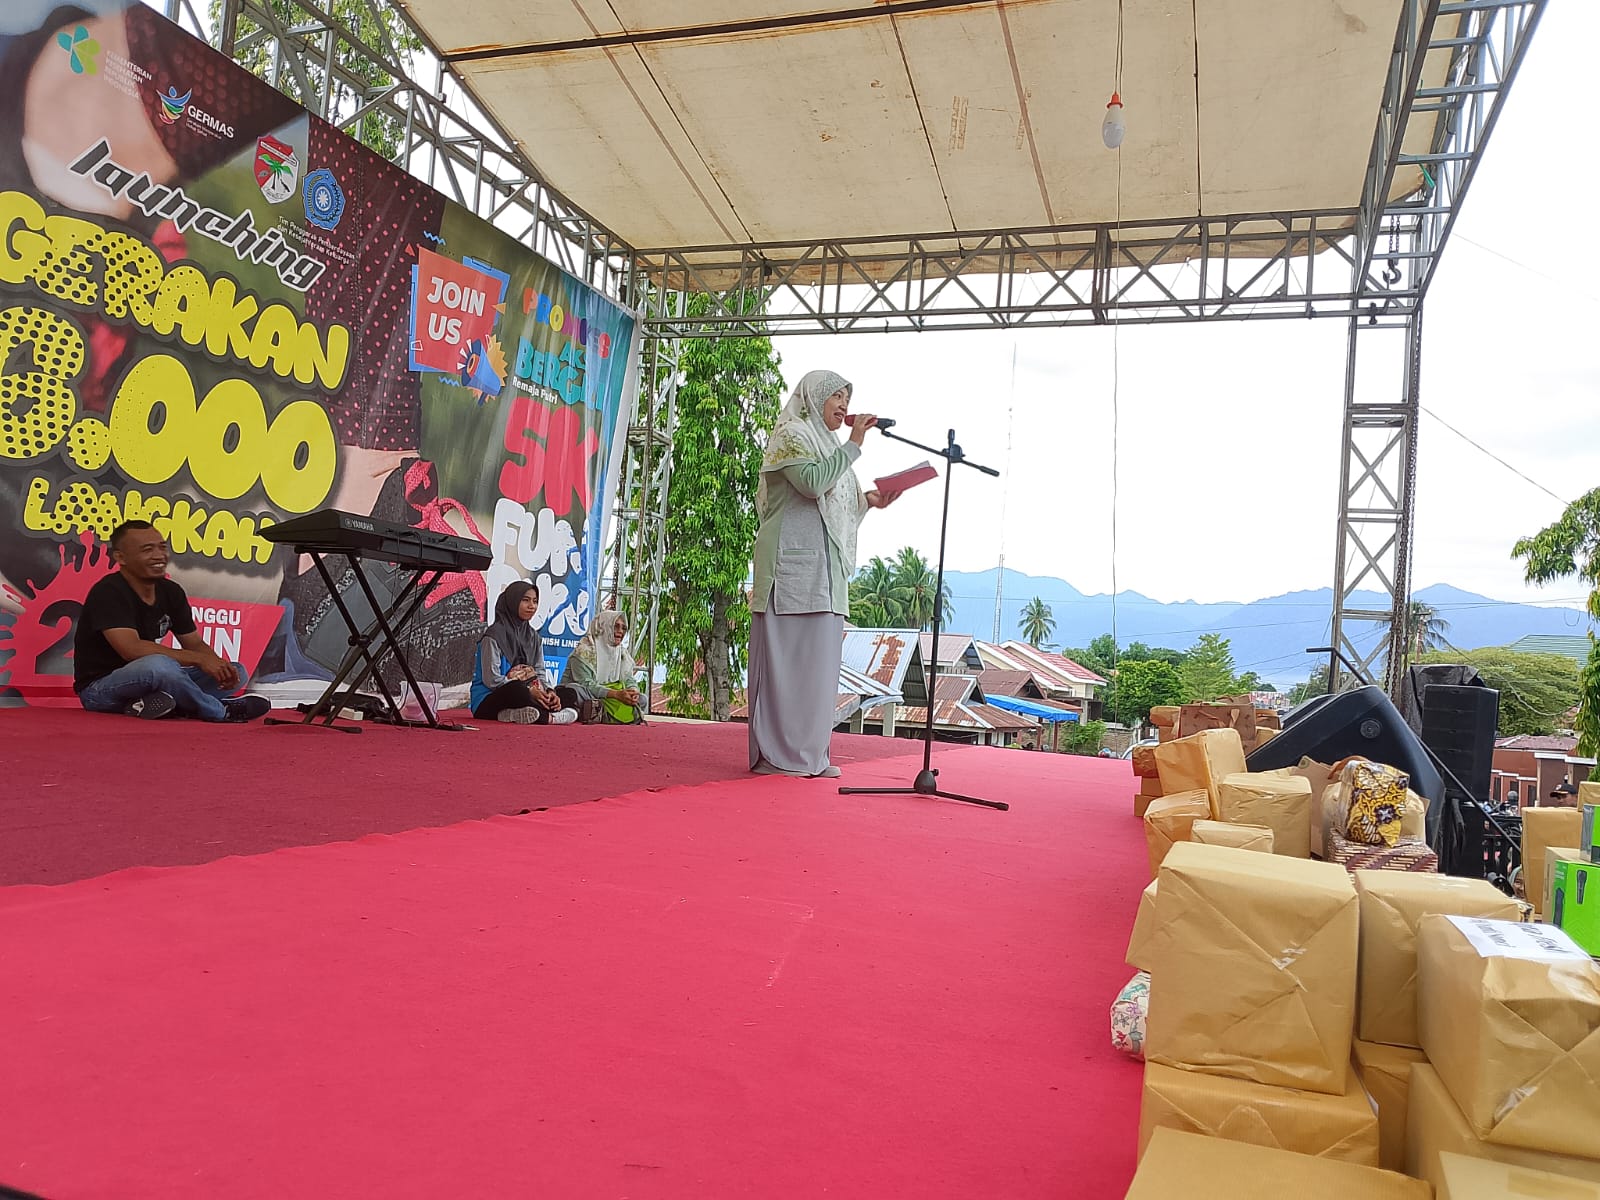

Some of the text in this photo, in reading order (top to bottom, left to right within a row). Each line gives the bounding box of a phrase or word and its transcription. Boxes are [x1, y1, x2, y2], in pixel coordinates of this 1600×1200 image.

[187, 105, 234, 138] GERMAS
[67, 136, 326, 292] launching
[0, 190, 349, 389] GERAKAN
[427, 276, 486, 317] JOIN
[428, 312, 463, 345] US
[512, 376, 559, 405] Remaja Putri
[498, 396, 600, 517] 5K
[351, 519, 375, 532] YAMAHA
[491, 497, 589, 578] FUN
[191, 606, 241, 626] NGGU
[541, 636, 580, 648] NISH LINE
